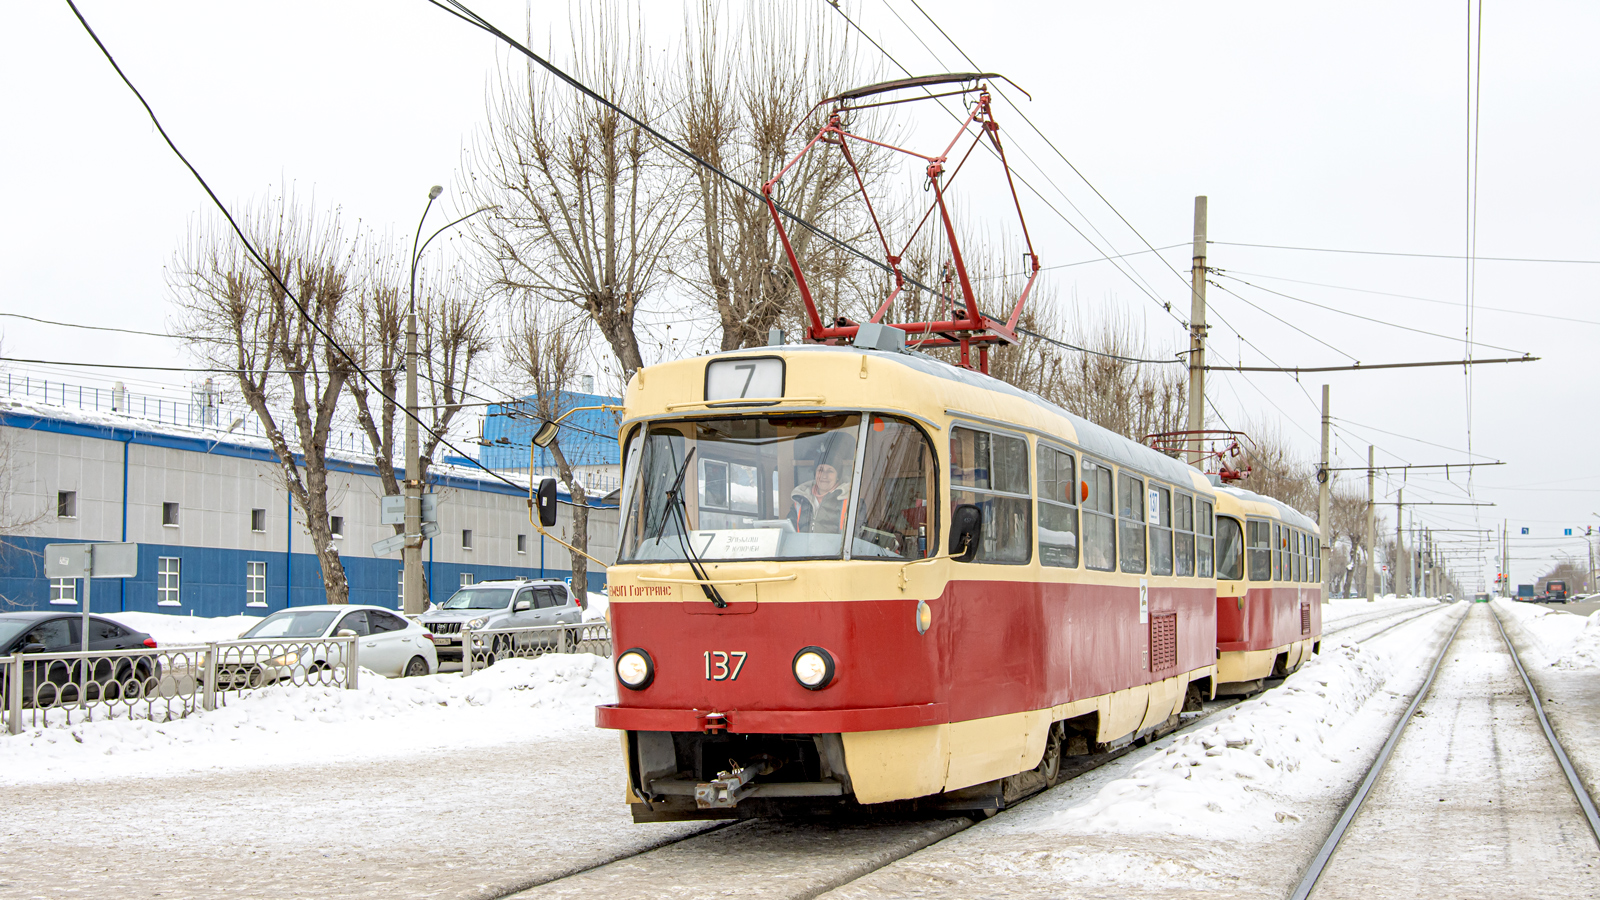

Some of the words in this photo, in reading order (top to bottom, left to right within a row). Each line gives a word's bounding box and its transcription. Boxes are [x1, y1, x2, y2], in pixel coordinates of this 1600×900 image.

[725, 364, 756, 398] 7
[698, 533, 717, 559] 7
[703, 650, 748, 681] 137
